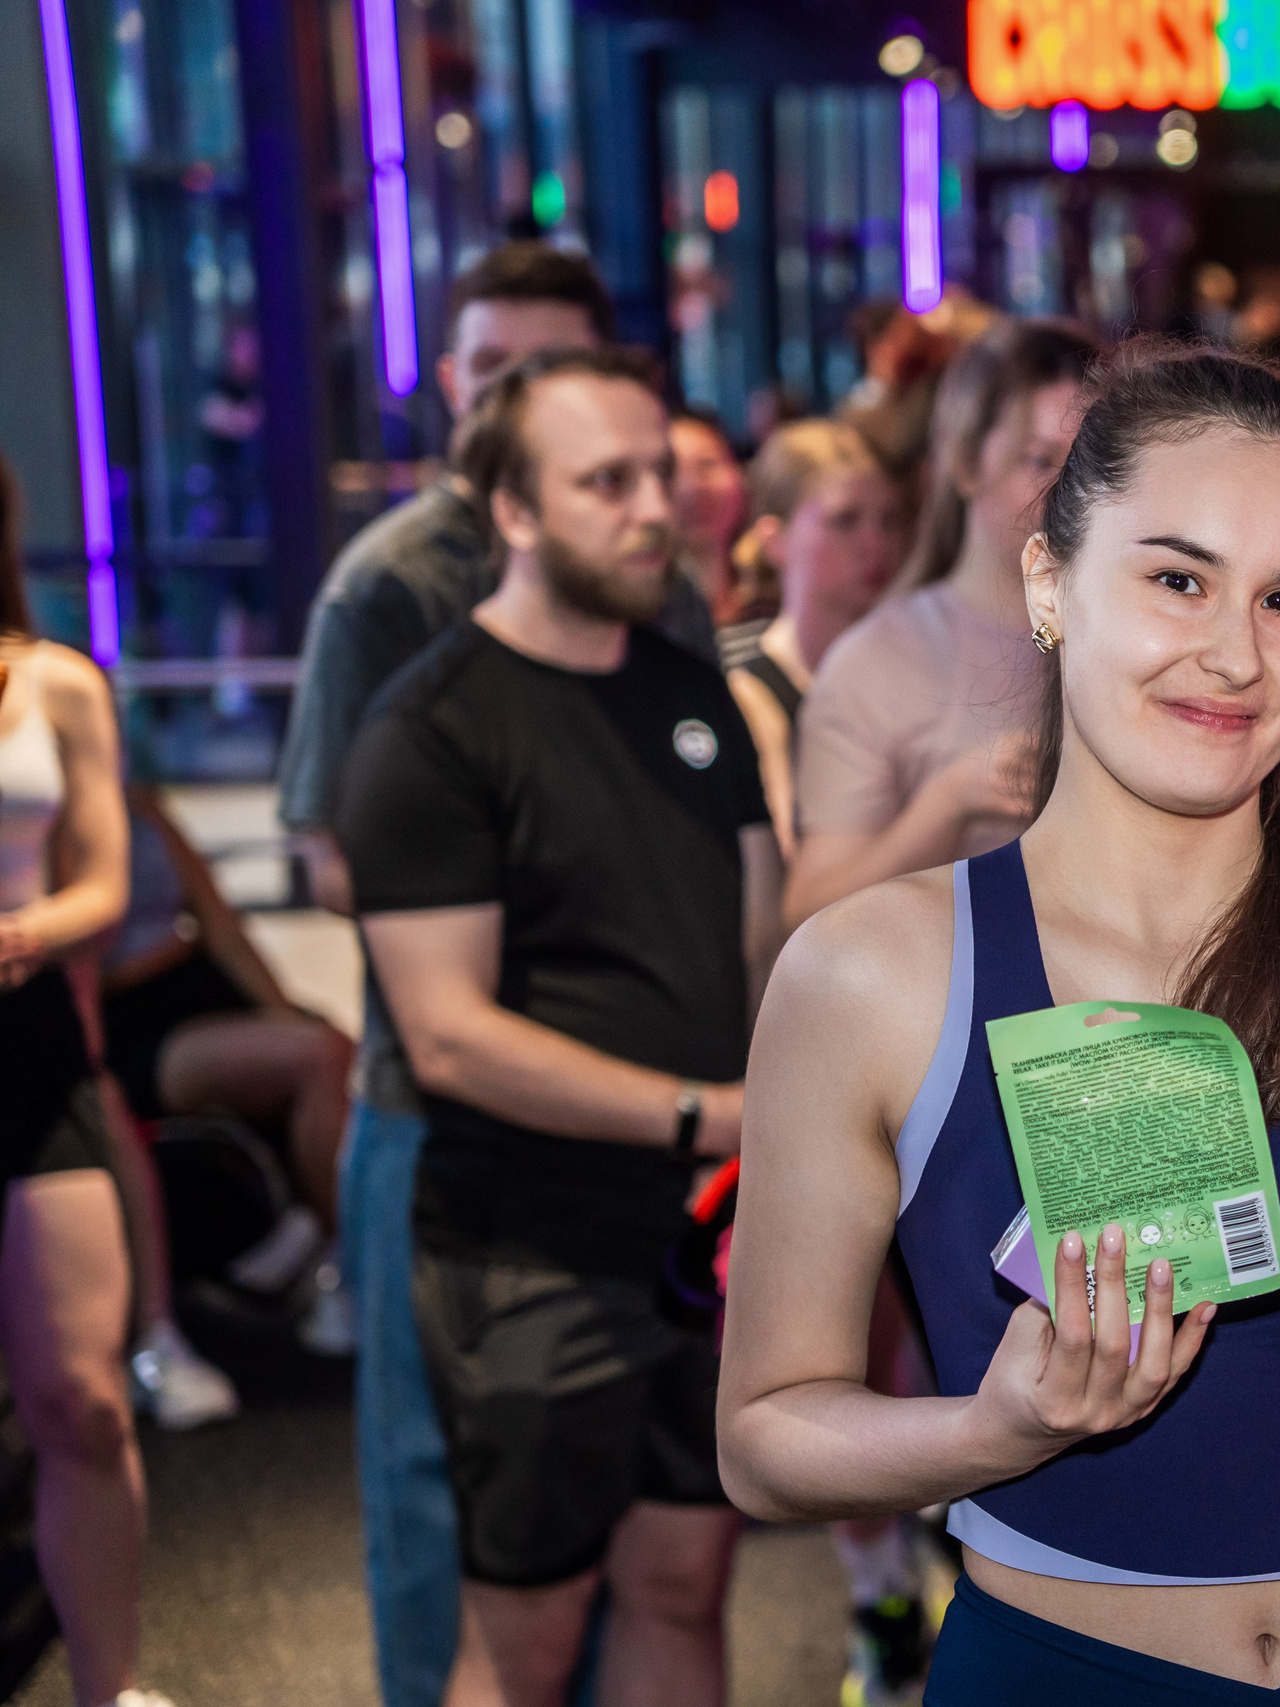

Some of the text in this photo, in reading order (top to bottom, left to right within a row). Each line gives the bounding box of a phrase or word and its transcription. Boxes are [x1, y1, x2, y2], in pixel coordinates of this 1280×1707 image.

[1011, 1057, 1043, 1069] ТКАНЕВАЯ
[1044, 1051, 1067, 1061] МАСКА
[1067, 1047, 1081, 1056] ДЛЯ
[1112, 1032, 1148, 1045] КРЕМОВОЙ
[1034, 1062, 1050, 1070] TAKE
[1057, 1056, 1072, 1065] EASY
[1079, 1048, 1108, 1060] МАСЛОМ
[1109, 1039, 1142, 1052] КОНОПЛИ
